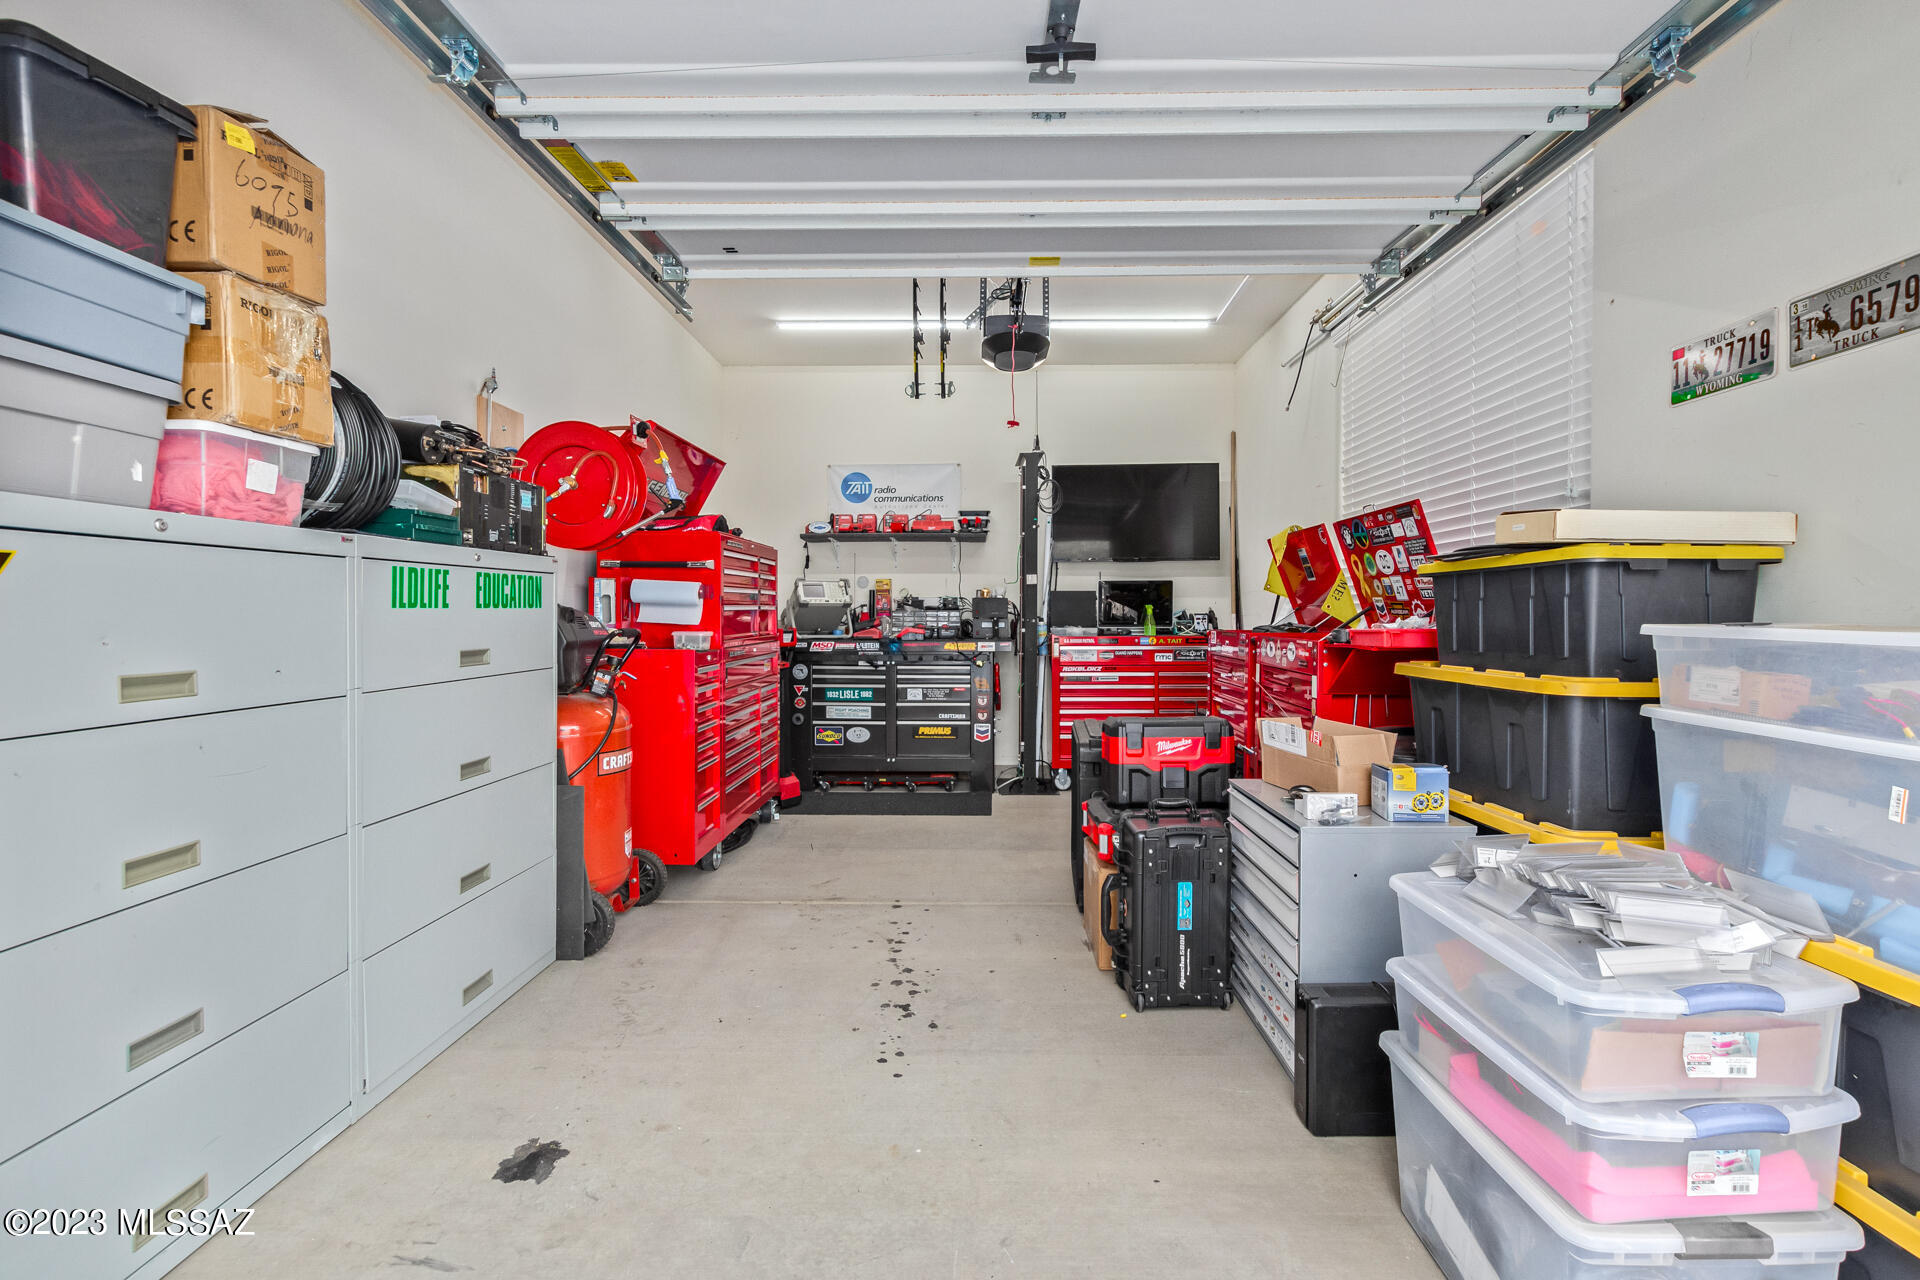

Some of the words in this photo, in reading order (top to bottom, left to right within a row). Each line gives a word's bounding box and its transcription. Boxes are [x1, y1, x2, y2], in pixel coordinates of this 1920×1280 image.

[235, 159, 298, 219] 6075
[1825, 270, 1891, 302] WYOMING
[1850, 274, 1920, 331] 6579
[1703, 327, 1736, 348] TRUCK
[1833, 326, 1880, 352] TRUCK
[1713, 328, 1770, 377] 27719
[1695, 373, 1744, 396] WYOMING
[184, 388, 213, 410] CE
[846, 481, 873, 494] TAIT
[874, 485, 897, 494] radio
[874, 494, 944, 503] communications
[391, 566, 450, 609] ILDLIFE
[475, 571, 542, 609] EDUCATION
[839, 689, 859, 699] LISLE
[918, 726, 952, 735] PRIMUS
[1155, 738, 1193, 752] Milwaukee
